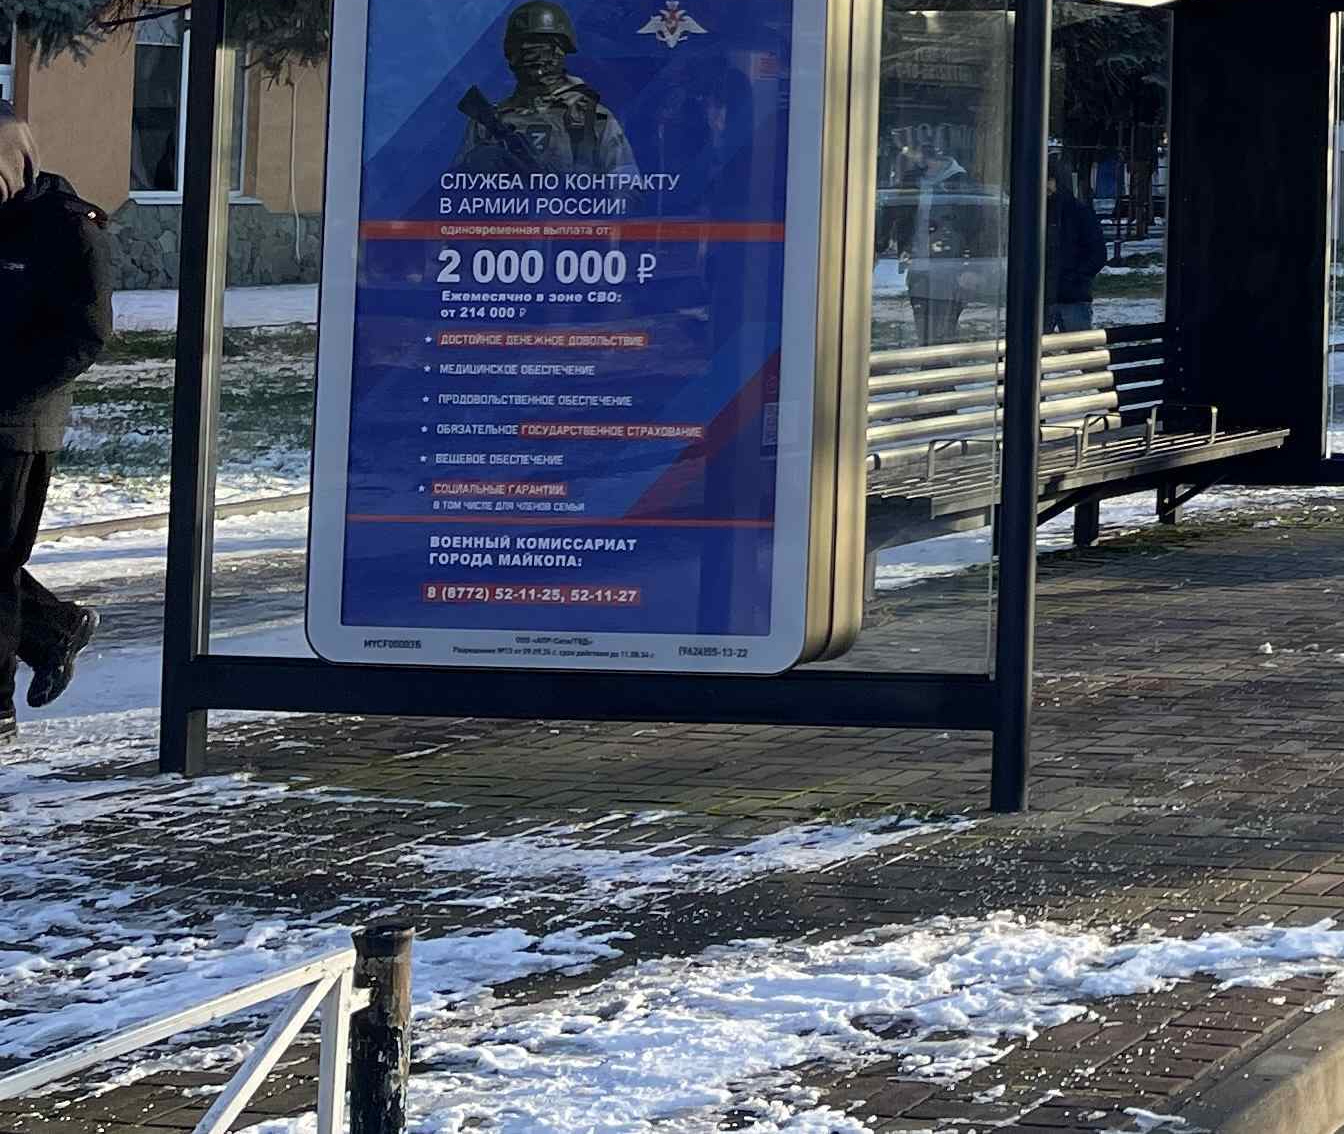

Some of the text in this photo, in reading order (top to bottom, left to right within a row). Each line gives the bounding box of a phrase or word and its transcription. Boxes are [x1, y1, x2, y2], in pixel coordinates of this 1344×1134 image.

[440, 173, 680, 191] СЛУЖБА ПО КОНТРАКТУ
[439, 198, 627, 215] В АРМИИ РОССИИ!
[440, 226, 540, 238] единовременная
[543, 227, 593, 237] выплата
[436, 249, 462, 283] 2
[472, 249, 544, 284] 000
[555, 249, 627, 284] 000
[441, 290, 622, 303] Ежемесячно в зоне СВО:
[440, 309, 455, 318] от
[460, 307, 485, 318] 214
[489, 307, 515, 318] 000
[440, 333, 645, 347] ДОСТОЙНОЕ ДЕНЕЖНОЕ ДОВОЛЬСТВИЕ
[439, 363, 596, 376] МЕДИЦИНСКОЕ ОБЕСПЕЧЕНИЕ
[438, 394, 633, 407] ПРОДОВОЛЬСТВЕННОЕ ОБЕСПЕЧЕНИЕ
[436, 424, 702, 437] ОБЯЗАТЕЛЬНОЕ ГОСУДАРСТВЕННОЕ СТРАХОВАНИЕ
[489, 454, 564, 465] ОБЕСПЕЧЕНИЕ
[433, 483, 505, 495] СОЦИАЛЬНЫЕ
[442, 501, 461, 510] ТОМ
[429, 535, 637, 551] ВОЕННЫЙ КОМИССАРИАТ
[429, 552, 583, 567] ГОРОДА МАЙКОПА:
[427, 586, 637, 603] 8 (8772) 52-11-25, 52-11-27
